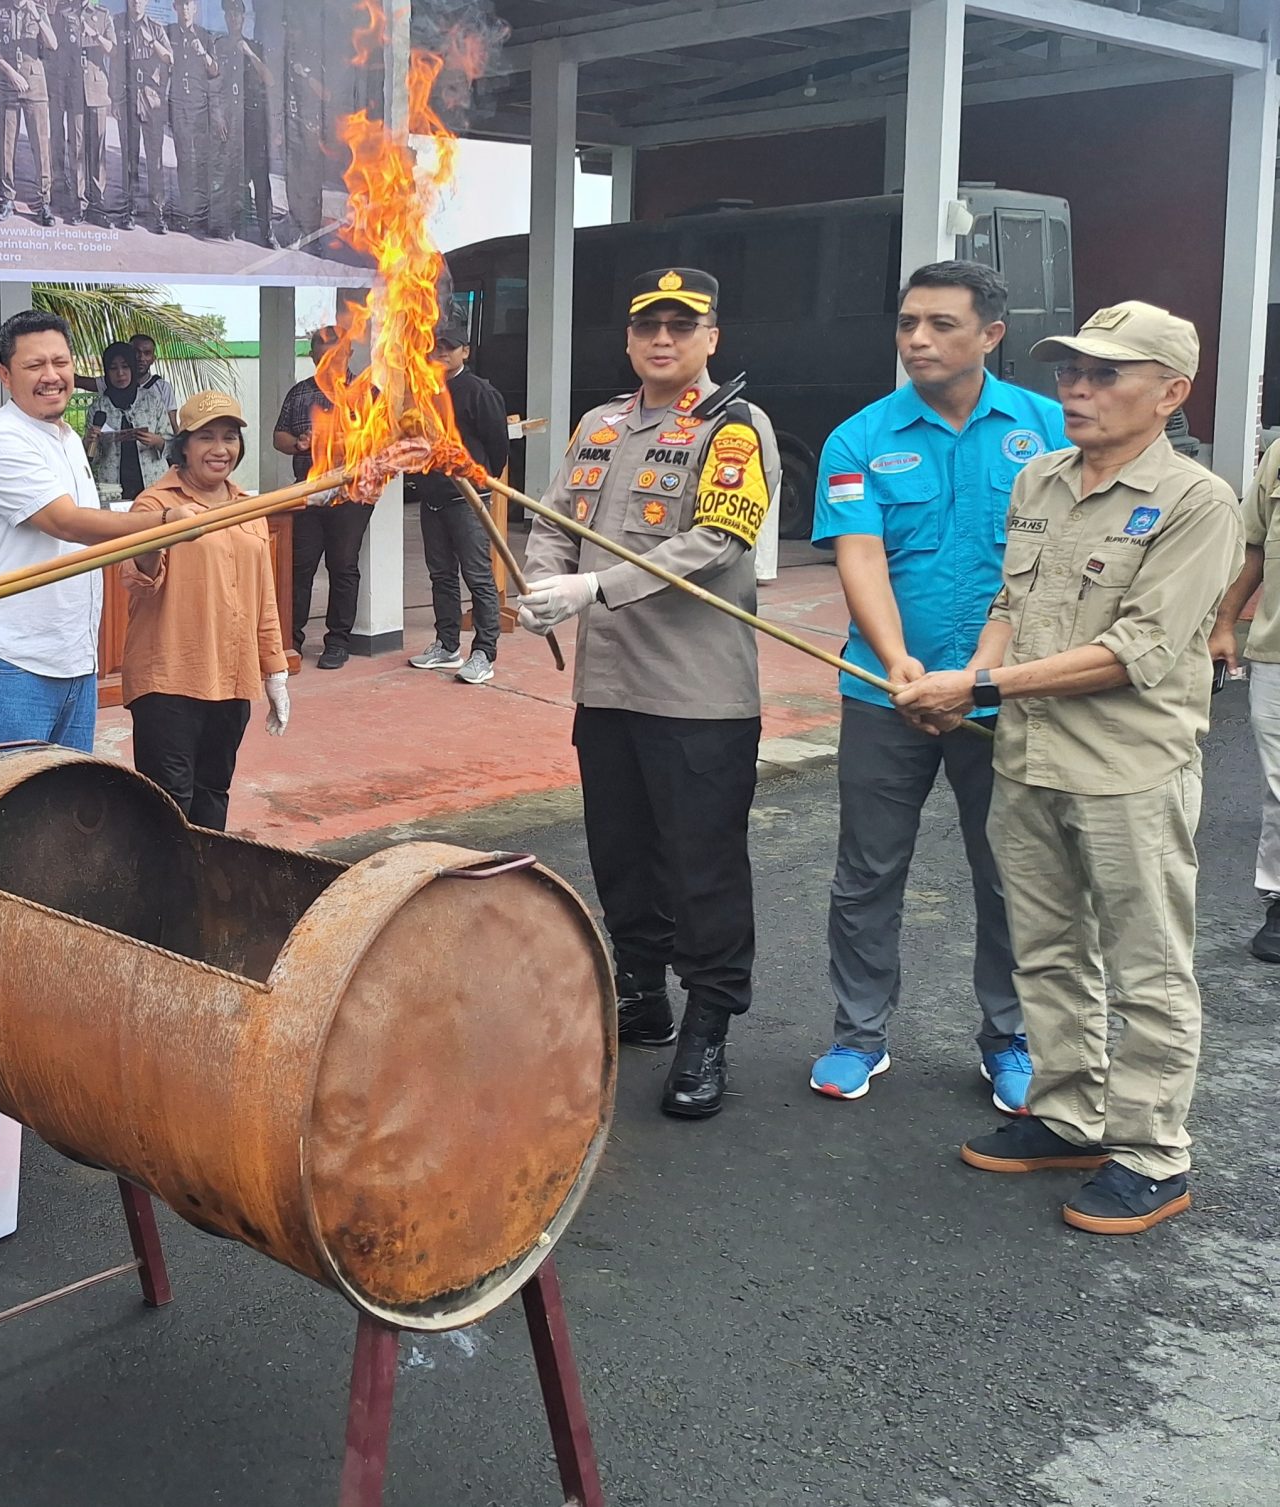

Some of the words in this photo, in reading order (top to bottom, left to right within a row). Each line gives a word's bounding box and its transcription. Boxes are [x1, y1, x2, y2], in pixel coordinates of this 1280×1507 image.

[0, 227, 119, 241] www.kejari-halut.go.id
[54, 242, 76, 251] Kec.
[78, 242, 112, 252] Tobelo
[645, 449, 690, 466] POLRI
